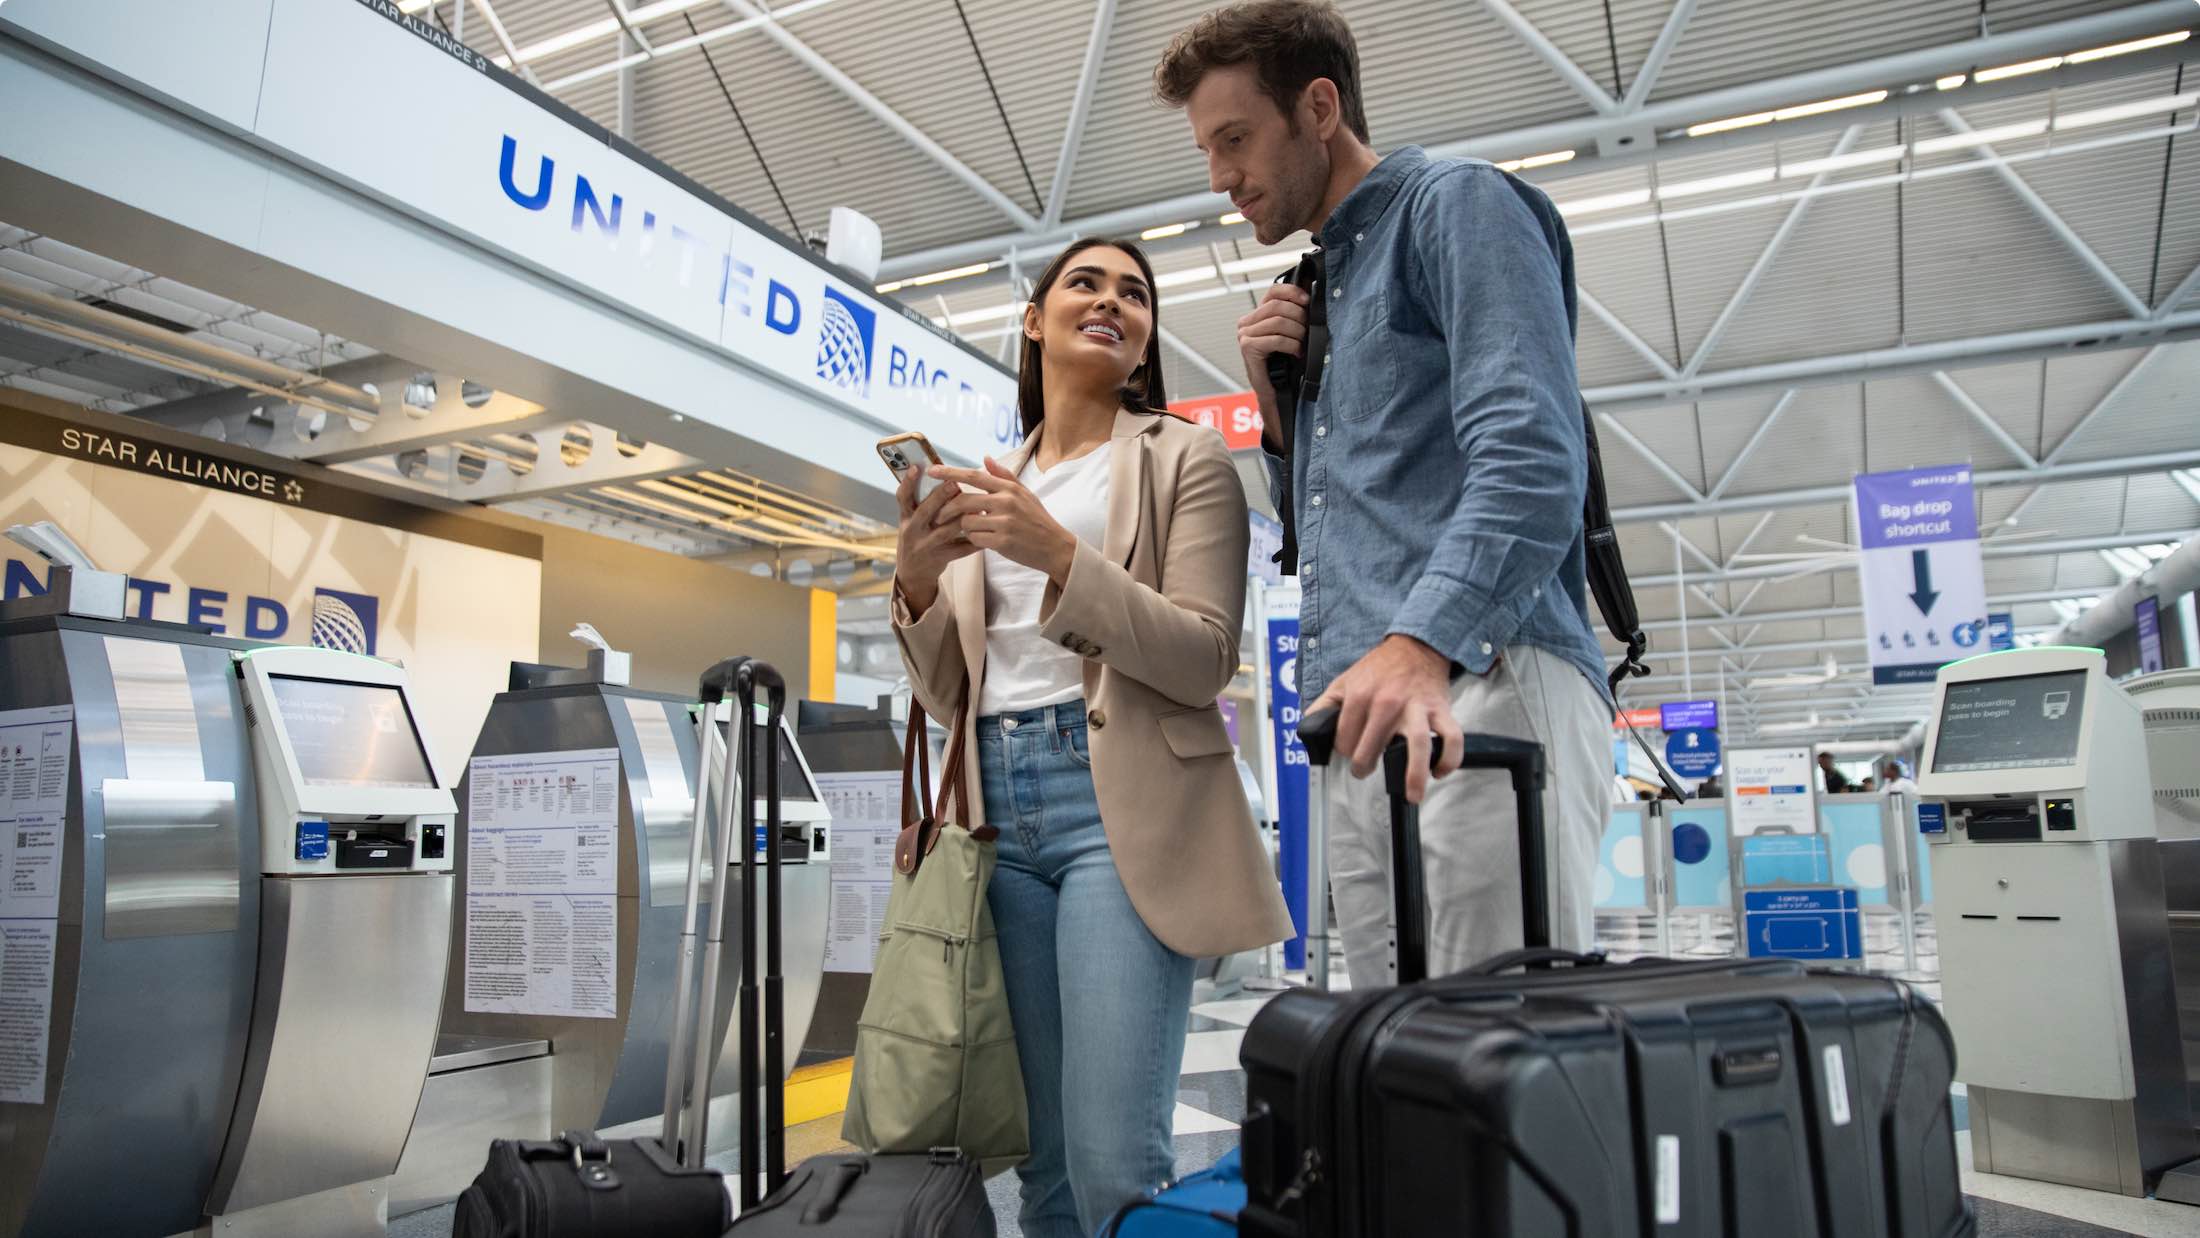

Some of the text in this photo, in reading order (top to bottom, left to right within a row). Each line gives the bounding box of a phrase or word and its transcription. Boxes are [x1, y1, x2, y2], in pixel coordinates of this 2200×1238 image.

[402, 15, 472, 63] ALLIANCE
[499, 134, 801, 335] UNITED
[62, 428, 276, 496] STAR ALLIANCE
[1880, 500, 1952, 520] Bag drop
[1885, 520, 1952, 539] shortcut
[4, 558, 289, 639] NTED
[1277, 635, 1299, 652] St
[1950, 698, 2016, 711] Scan boarding
[1971, 711, 1981, 719] to
[1983, 708, 2010, 719] begin
[1282, 706, 1304, 724] Dr
